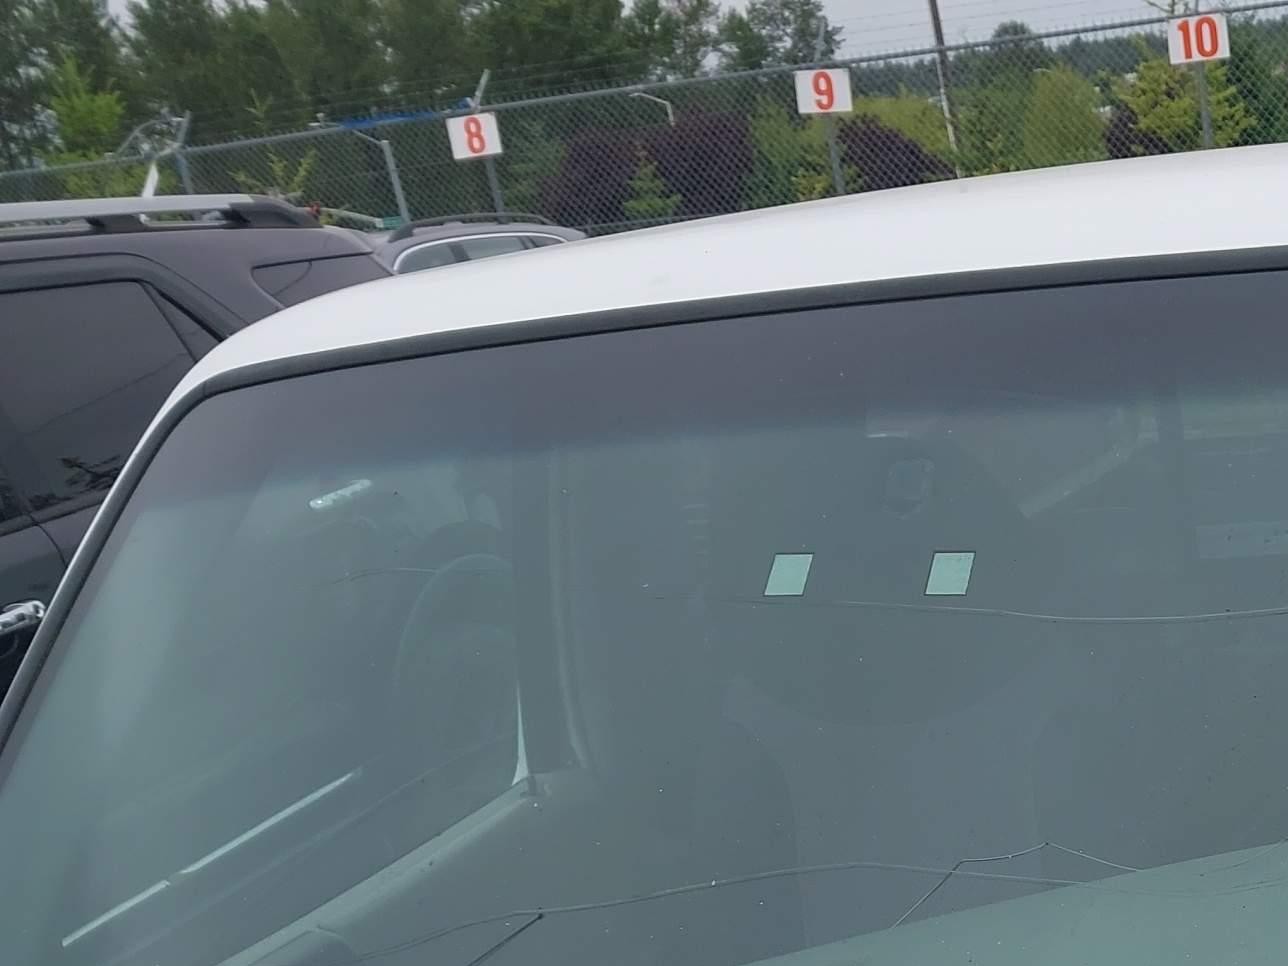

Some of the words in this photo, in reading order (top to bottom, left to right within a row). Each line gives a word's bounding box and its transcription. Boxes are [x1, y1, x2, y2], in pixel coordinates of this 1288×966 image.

[1177, 15, 1220, 59] 10
[812, 71, 836, 111] 9
[464, 117, 487, 154] 8
